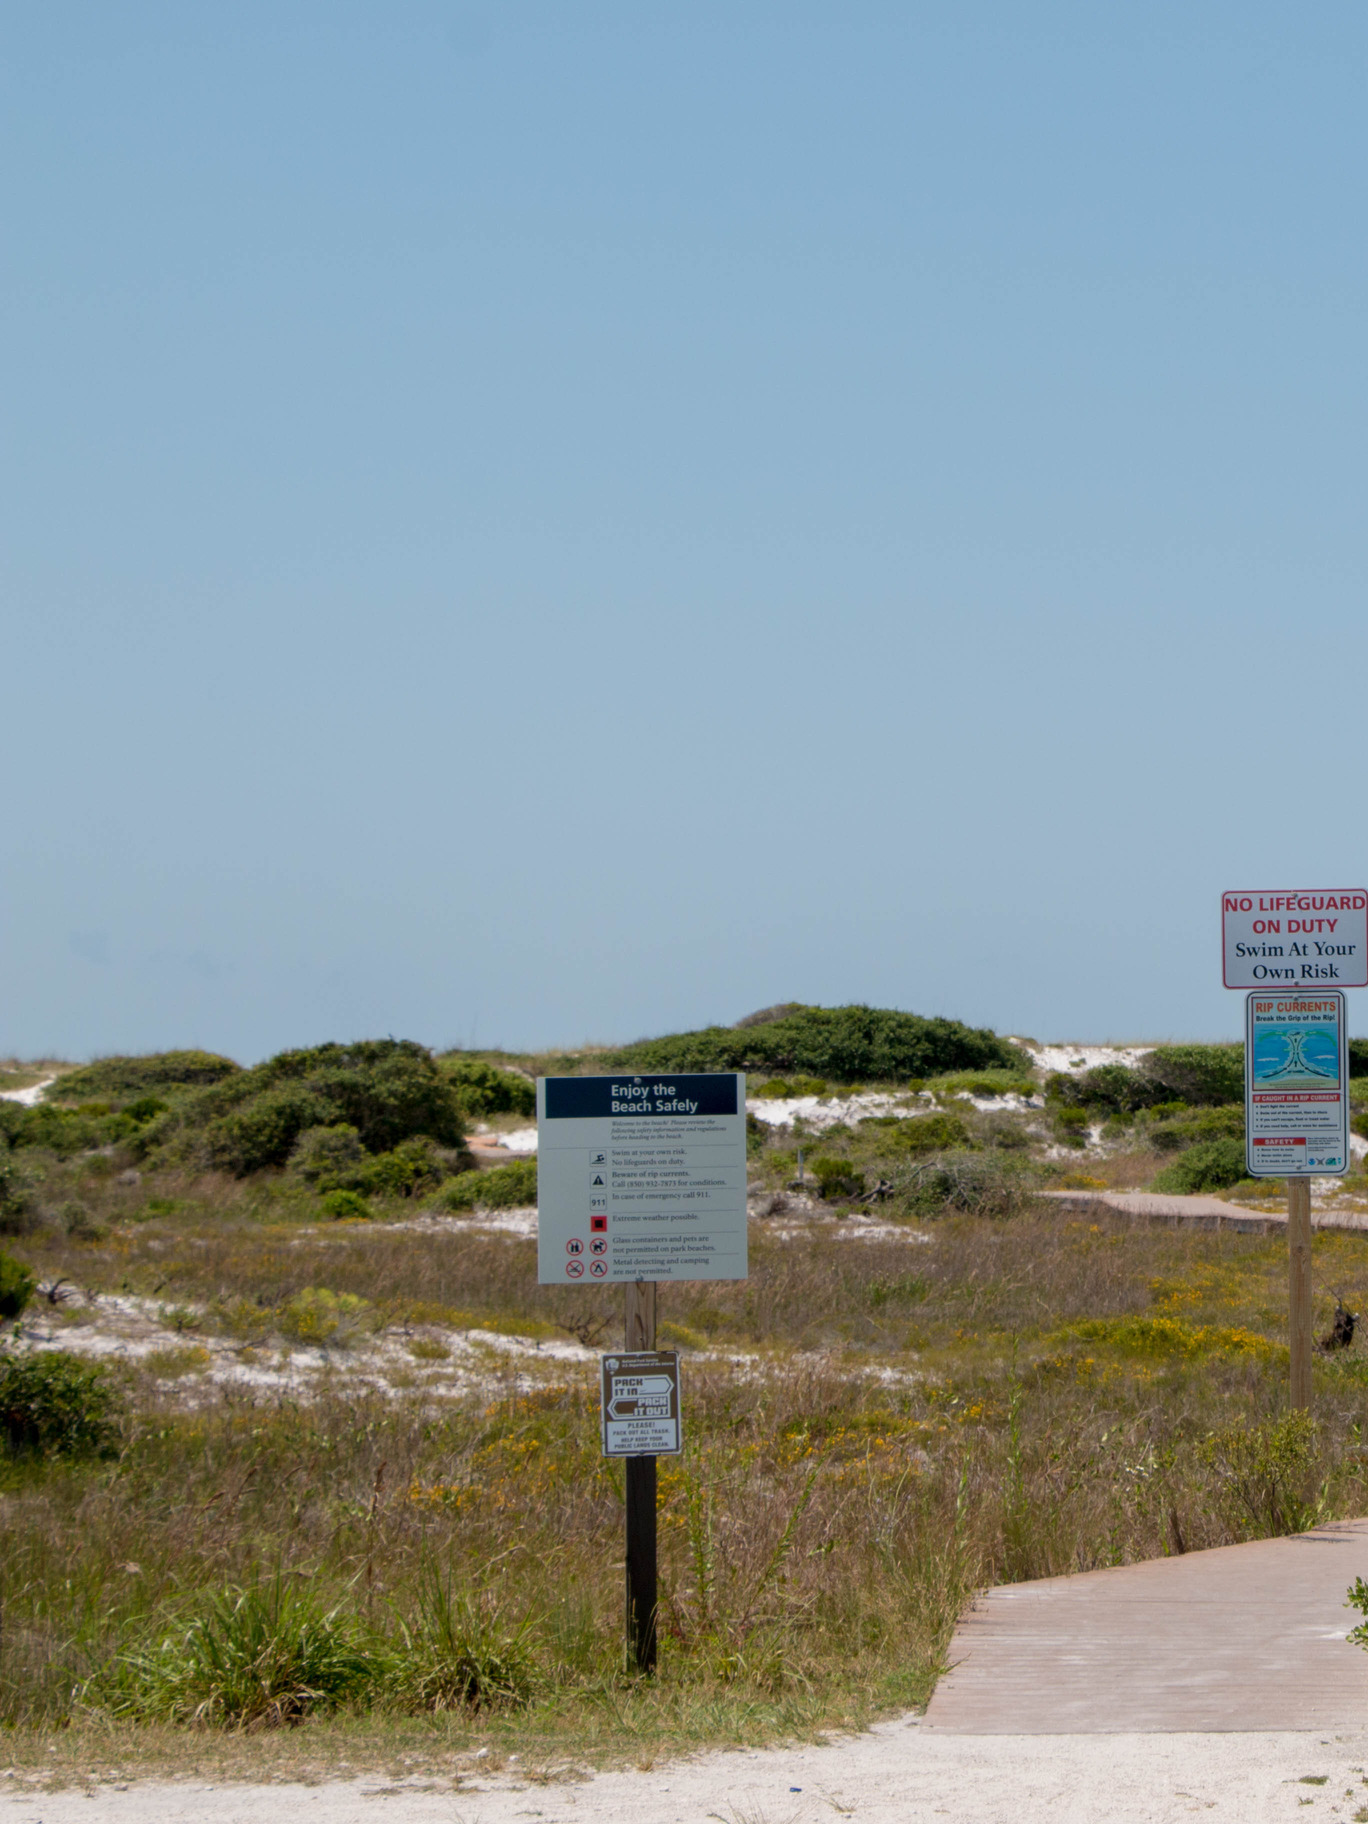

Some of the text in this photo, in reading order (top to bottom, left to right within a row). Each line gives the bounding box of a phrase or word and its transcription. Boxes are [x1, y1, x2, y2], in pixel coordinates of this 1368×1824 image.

[1225, 896, 1366, 912] NO LIFEGUARD
[1253, 919, 1338, 934] ON DUTY
[1236, 941, 1356, 957] Swim At Your
[1253, 963, 1339, 979] Own Risk
[1256, 1001, 1336, 1013] RIP CURRENTS
[611, 1083, 676, 1099] Enjoy the
[611, 1099, 698, 1114] Beach Safely
[624, 1158, 657, 1167] lifeguards
[591, 1198, 606, 1207] 911
[670, 1214, 698, 1222] possible.
[625, 1246, 659, 1254] permitted
[671, 1245, 686, 1253] park
[634, 1258, 665, 1266] detecting
[680, 1257, 710, 1265] camping
[638, 1267, 672, 1275] permitted.
[615, 1378, 643, 1387] PACK
[615, 1388, 625, 1396] IT
[638, 1397, 667, 1406] PACK
[634, 1407, 668, 1416] IT OUT
